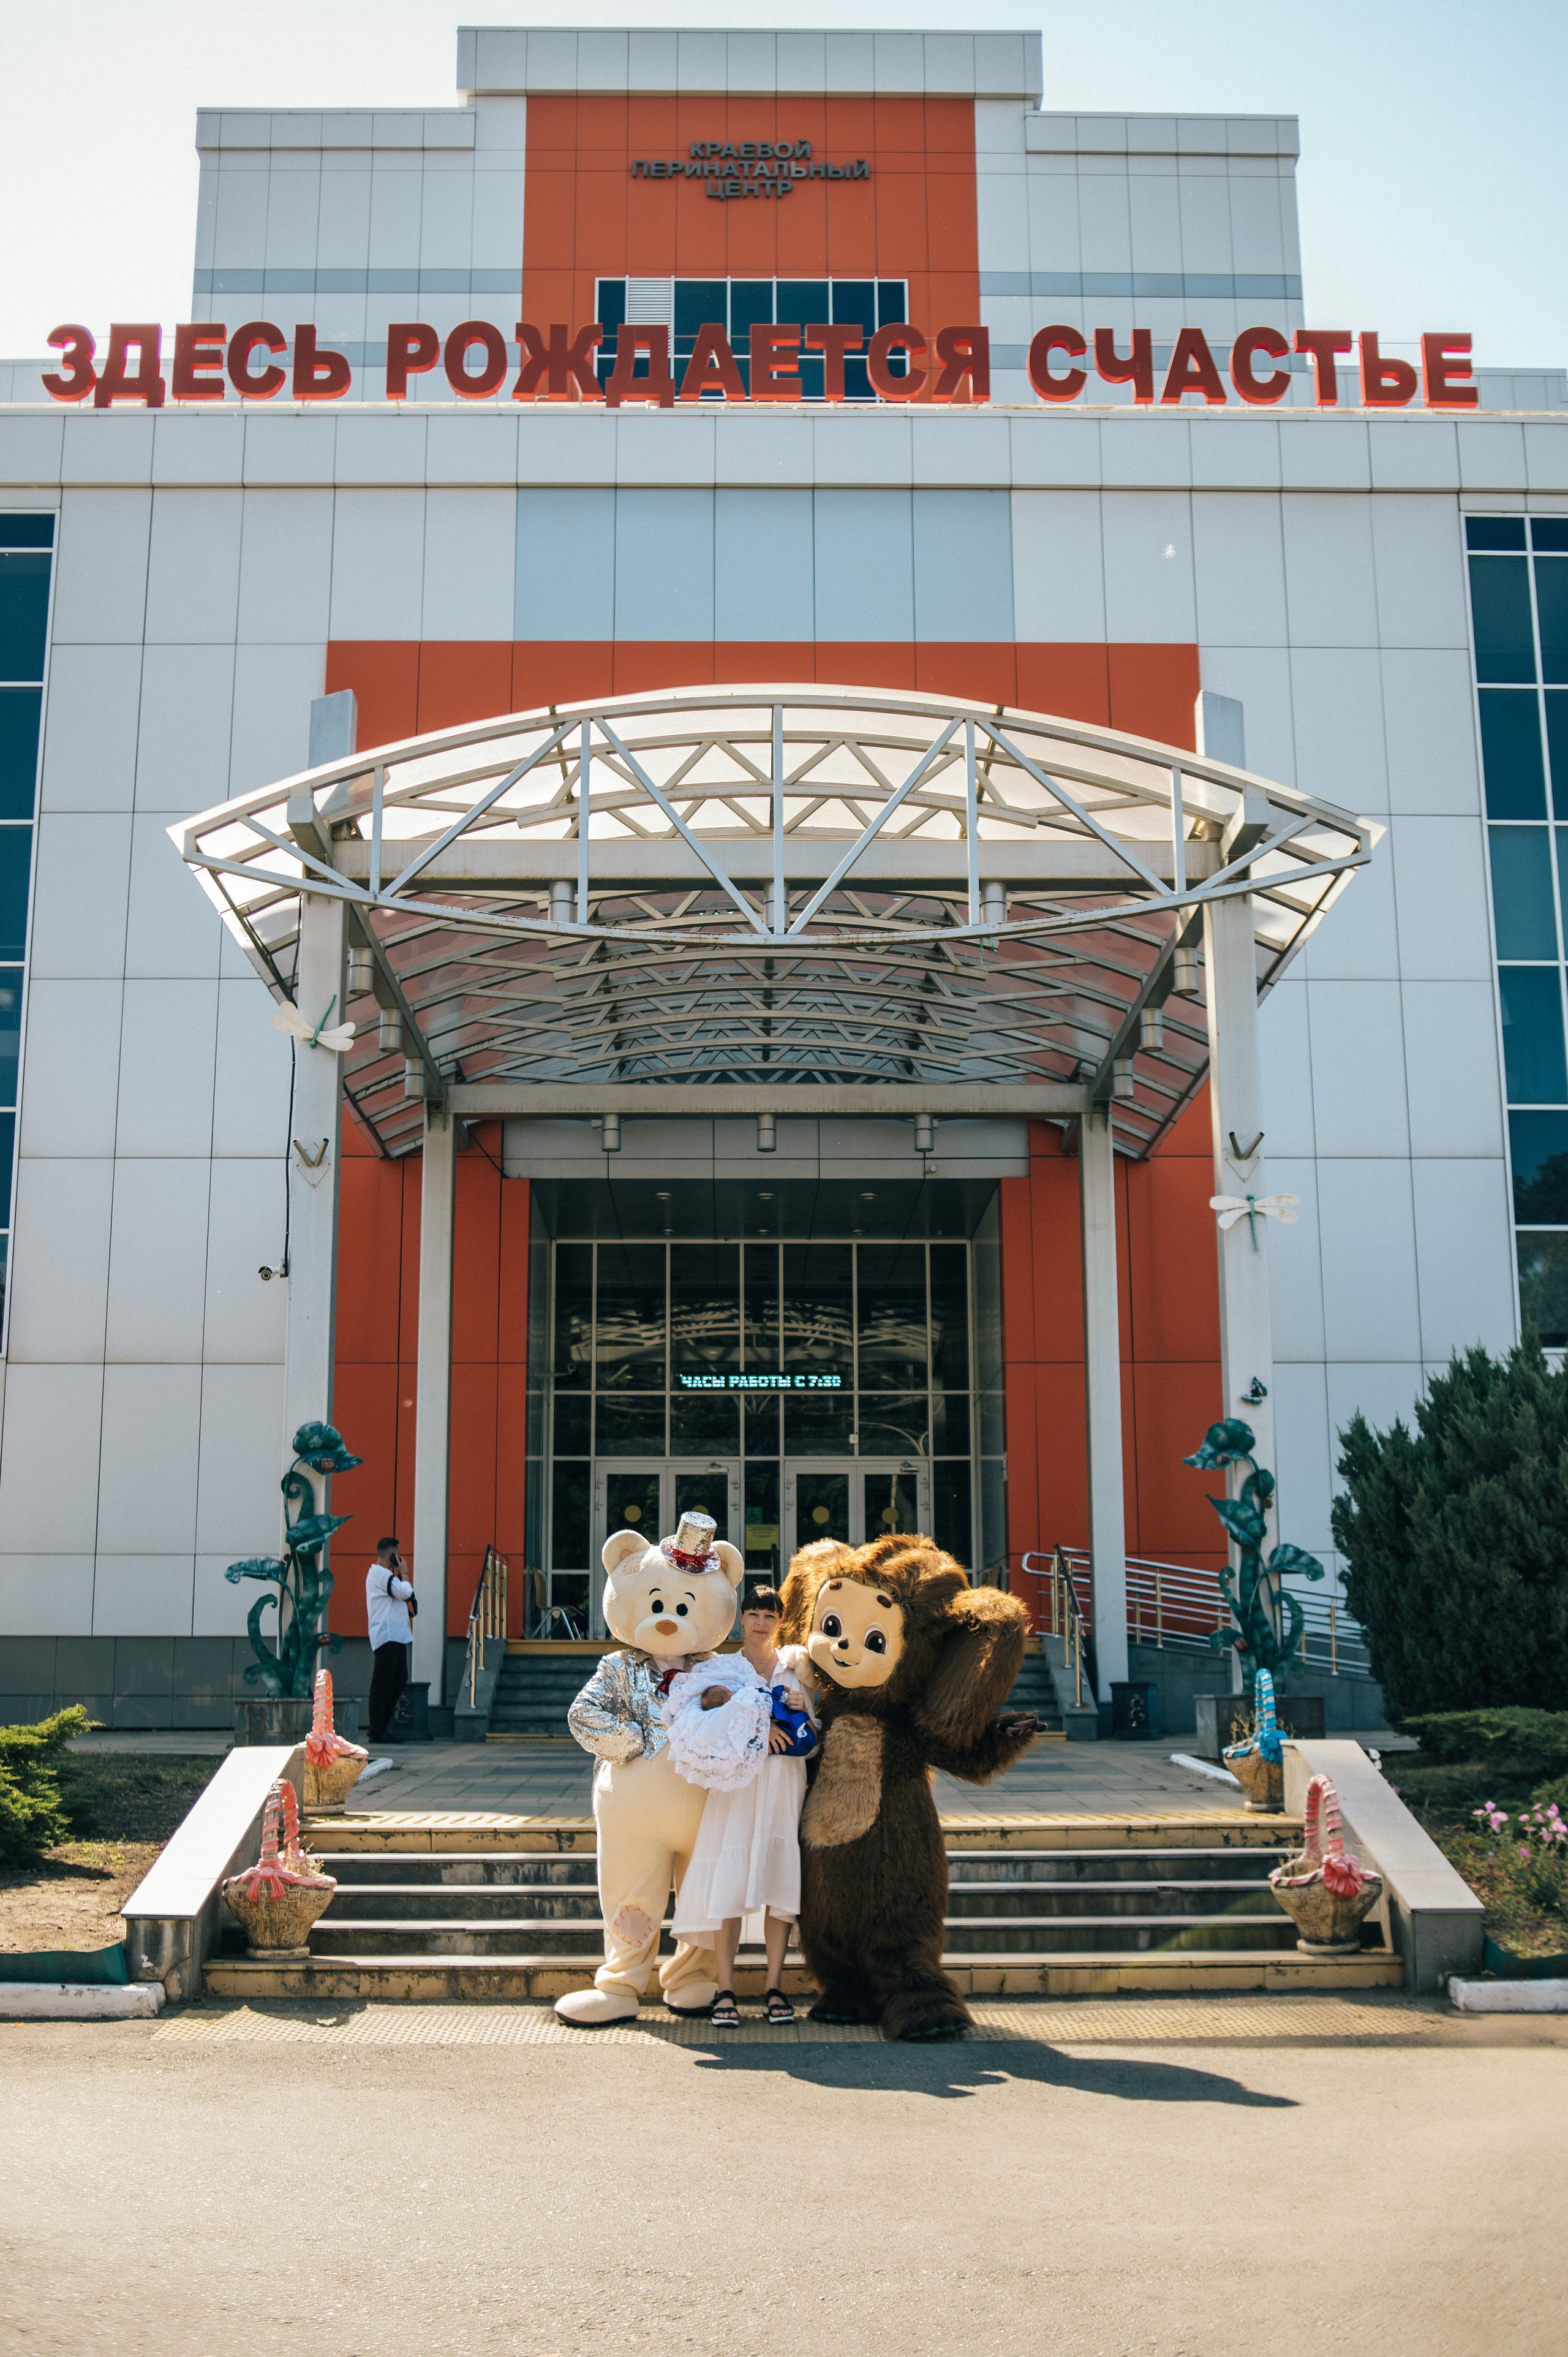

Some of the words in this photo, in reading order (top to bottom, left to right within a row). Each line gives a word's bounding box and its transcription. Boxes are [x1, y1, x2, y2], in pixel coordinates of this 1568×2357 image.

[690, 138, 812, 160] КРАЕВОЙ
[631, 159, 870, 180] ПЕРИНАТАЛЬНЫЙ
[706, 180, 793, 200] ЦЕНТР
[41, 320, 352, 409] ЗДЕСЬ
[385, 320, 990, 409] РОЖДАЕТСЯ
[1027, 323, 1479, 409] СЧАСТЬЕ
[680, 1375, 725, 1388] ЧАСЫ
[728, 1375, 791, 1388] РАБОТЫ
[794, 1375, 805, 1387] С
